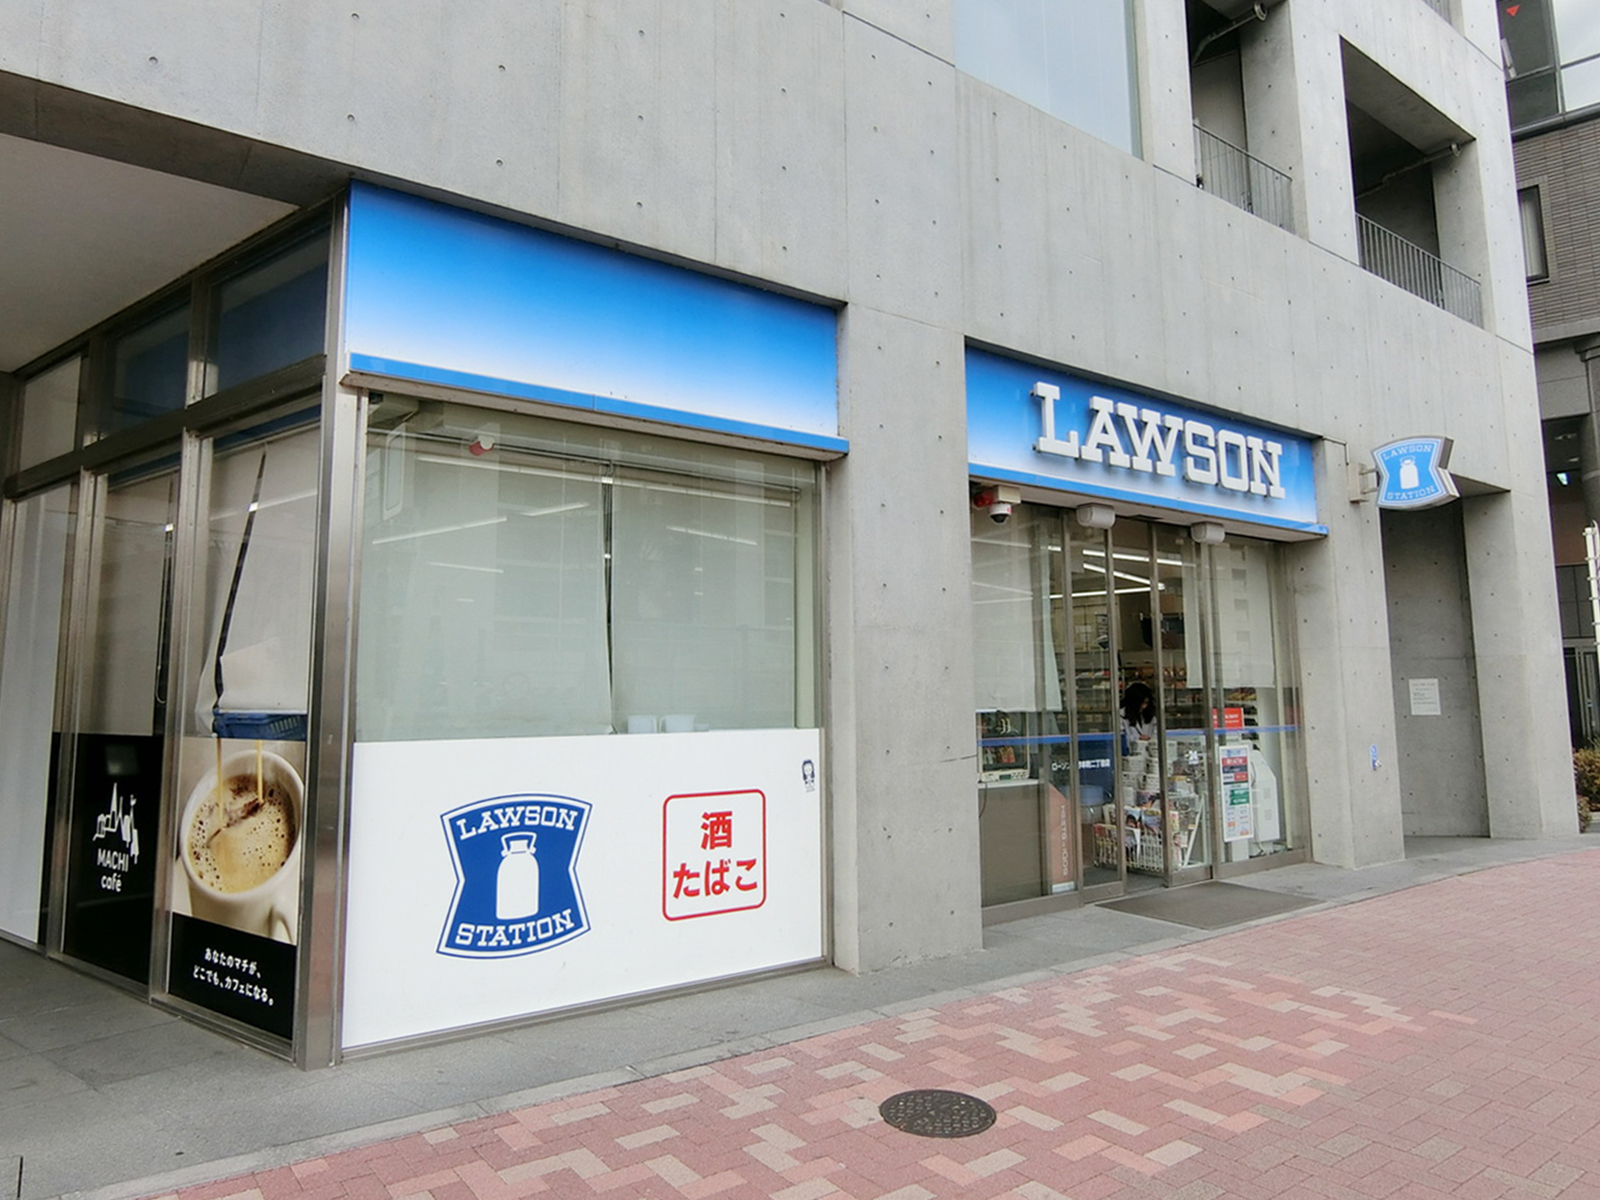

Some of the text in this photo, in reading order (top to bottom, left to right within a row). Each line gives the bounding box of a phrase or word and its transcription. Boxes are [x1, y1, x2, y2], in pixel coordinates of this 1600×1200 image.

[1033, 381, 1285, 499] LAWSON
[1382, 444, 1433, 460] LAWSON
[1386, 485, 1436, 500] STATION
[456, 805, 578, 840] LAWSON
[700, 810, 733, 850] 酒
[97, 848, 129, 872] MACHI
[100, 872, 122, 893] café
[673, 858, 758, 900] たばこ
[454, 908, 575, 947] STATION
[204, 947, 261, 979] あなたのマチが、
[193, 965, 274, 1006] どこでも、カフェになる。
